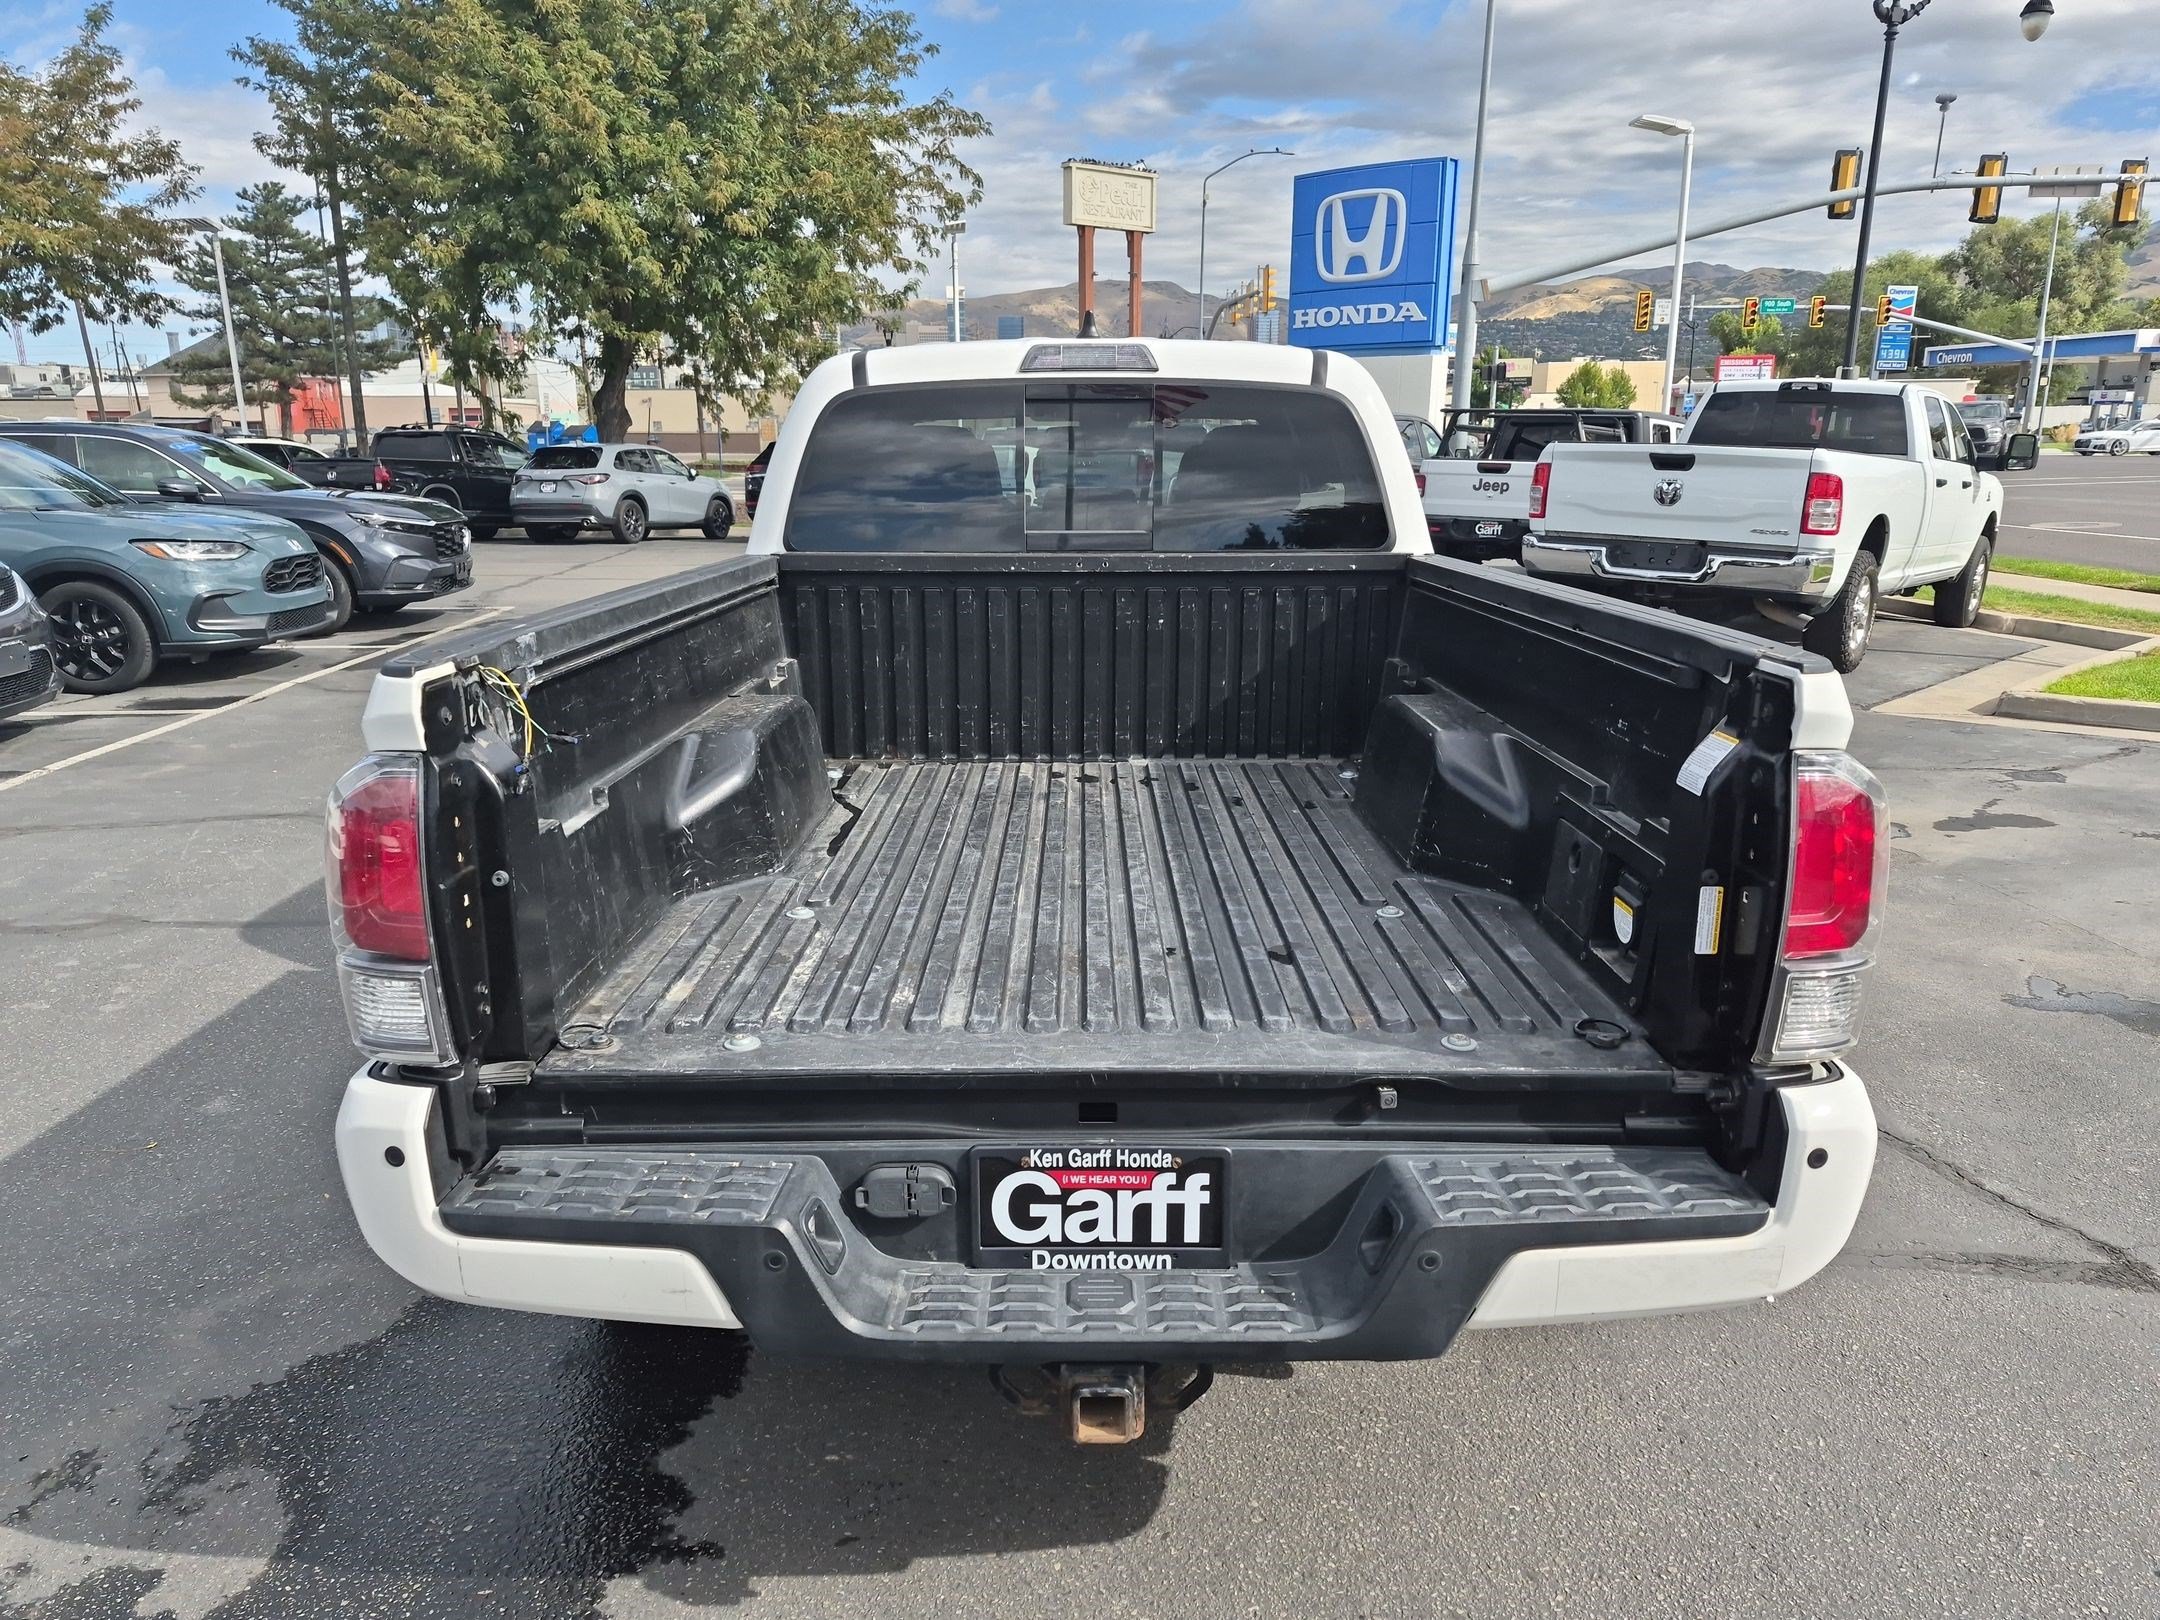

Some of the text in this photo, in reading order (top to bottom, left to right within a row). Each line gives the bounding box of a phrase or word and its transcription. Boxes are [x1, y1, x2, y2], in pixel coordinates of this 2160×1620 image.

[1099, 180, 1146, 208] Pearl
[1082, 202, 1145, 221] RESTAURANT
[1292, 301, 1427, 329] HONDA
[1936, 352, 1973, 364] Chevron
[1472, 477, 1510, 495] Jeep
[1030, 1148, 1172, 1168] Ken Garff Honda
[1071, 1175, 1139, 1184] WE HEAR YOU
[991, 1170, 1210, 1244] Garff
[1032, 1250, 1172, 1269] Downtown
